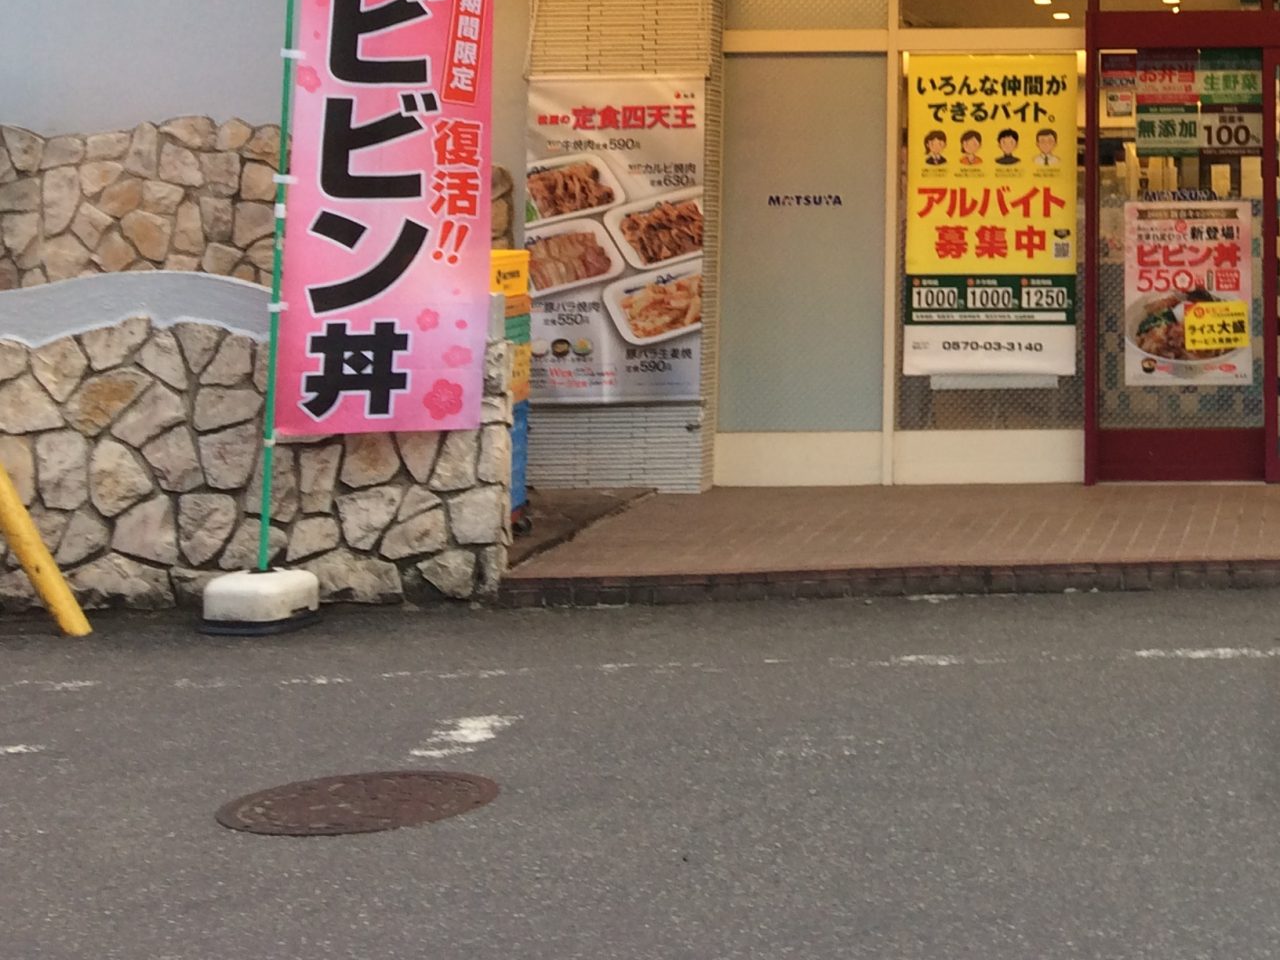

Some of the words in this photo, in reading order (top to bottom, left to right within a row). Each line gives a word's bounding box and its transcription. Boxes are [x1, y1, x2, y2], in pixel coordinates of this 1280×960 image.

[916, 75, 1068, 97] いろんな仲間が
[928, 102, 1056, 124] できるバイト。
[1138, 119, 1198, 139] 無添加
[767, 194, 843, 206] MATSUYA
[917, 186, 1067, 219] アルバイト
[935, 225, 1047, 260] 募集中
[915, 289, 957, 308] 1000
[970, 289, 1013, 308] 1000
[1025, 289, 1066, 308] 1250
